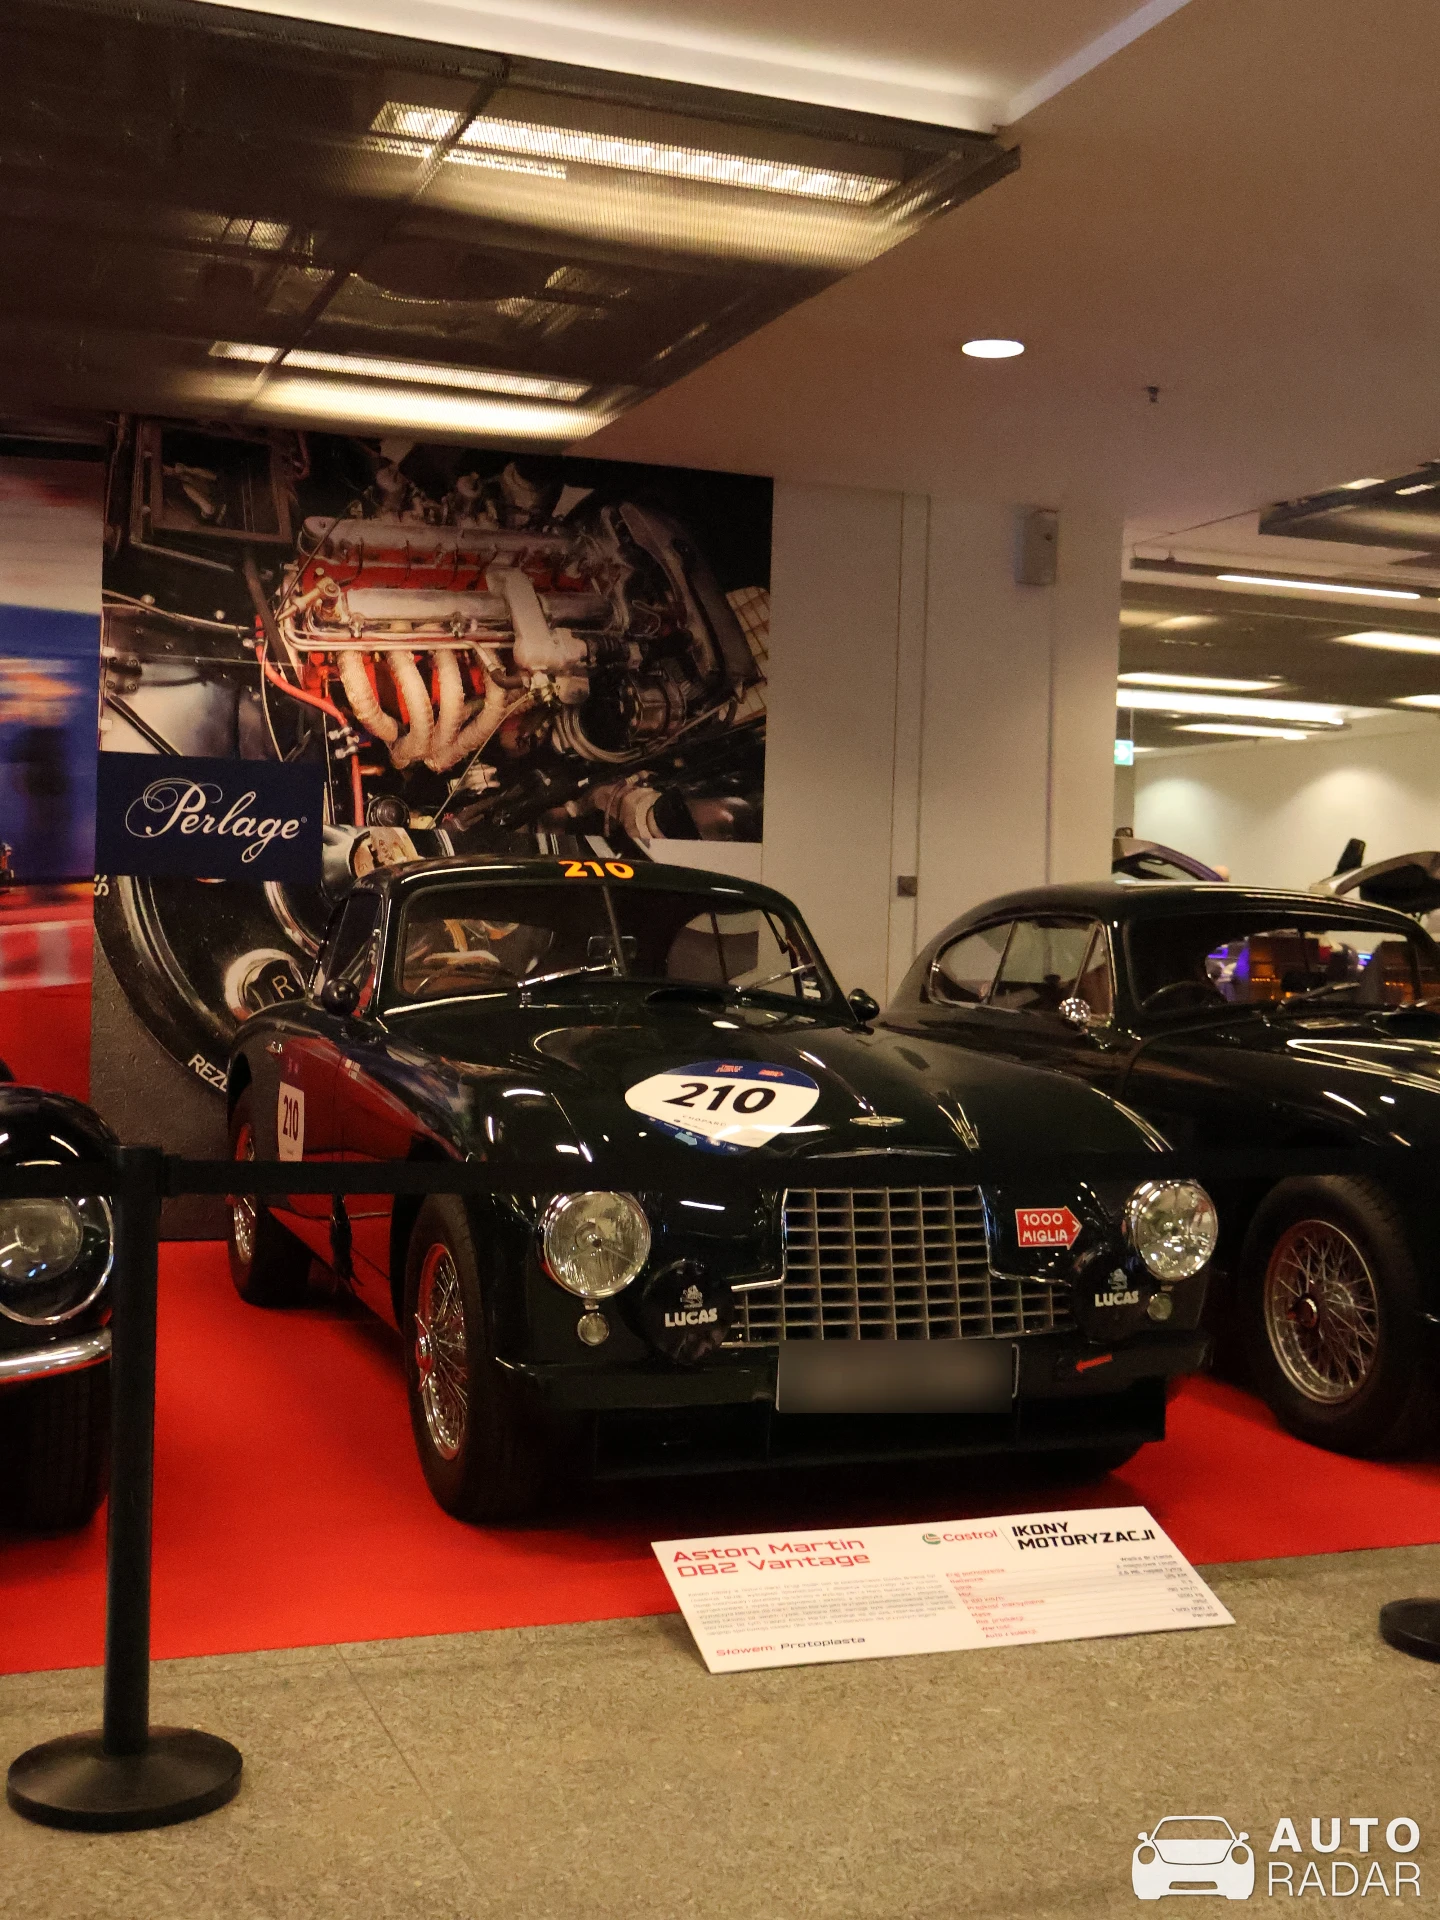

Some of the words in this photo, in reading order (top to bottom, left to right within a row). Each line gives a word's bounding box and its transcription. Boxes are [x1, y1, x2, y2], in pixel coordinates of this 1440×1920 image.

[125, 777, 300, 863] Perlage
[558, 860, 635, 879] 210
[272, 975, 295, 999] R
[662, 1082, 777, 1114] 210
[282, 1095, 299, 1141] 210
[1023, 1213, 1063, 1226] 1000
[1022, 1229, 1068, 1243] MIGLIA
[1094, 1290, 1139, 1308] LUCAS
[664, 1307, 718, 1328] LUCAS
[943, 1530, 998, 1543] Castrol
[1011, 1522, 1069, 1537] IKONY
[1017, 1529, 1156, 1550] MOTORYZACJI
[673, 1545, 760, 1563] Aston
[769, 1538, 865, 1556] Martin
[677, 1562, 739, 1578] DB2
[749, 1553, 871, 1571] Vantage
[780, 1636, 866, 1651] Protoplasta
